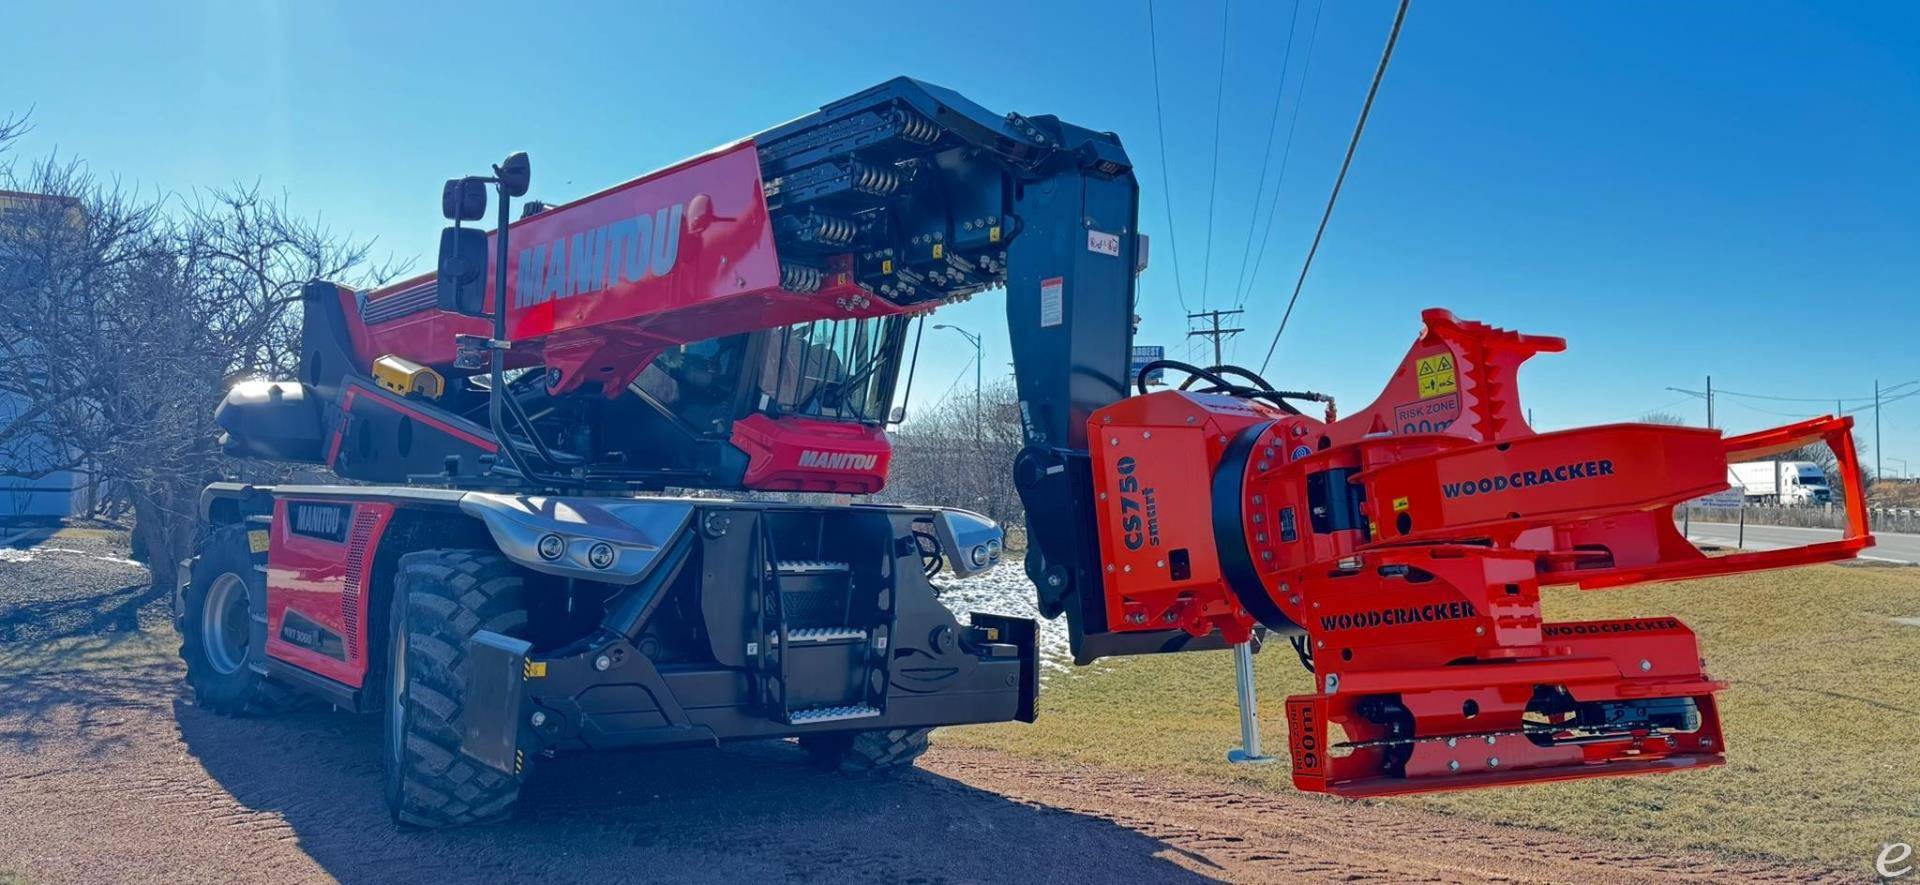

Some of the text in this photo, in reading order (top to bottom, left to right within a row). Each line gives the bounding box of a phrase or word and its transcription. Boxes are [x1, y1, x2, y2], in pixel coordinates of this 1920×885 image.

[514, 203, 684, 310] MANITOU
[1399, 400, 1456, 420] RISK ZONE
[798, 450, 878, 470] MANITOU
[1443, 459, 1614, 498] WOODCRACKER
[296, 505, 340, 533] MANITOU
[1117, 456, 1143, 550] CS750
[1142, 488, 1160, 546] smart
[1320, 600, 1475, 631] WOODCRACKER
[1543, 619, 1677, 636] WOODCRACKER
[1302, 707, 1318, 768] 90m
